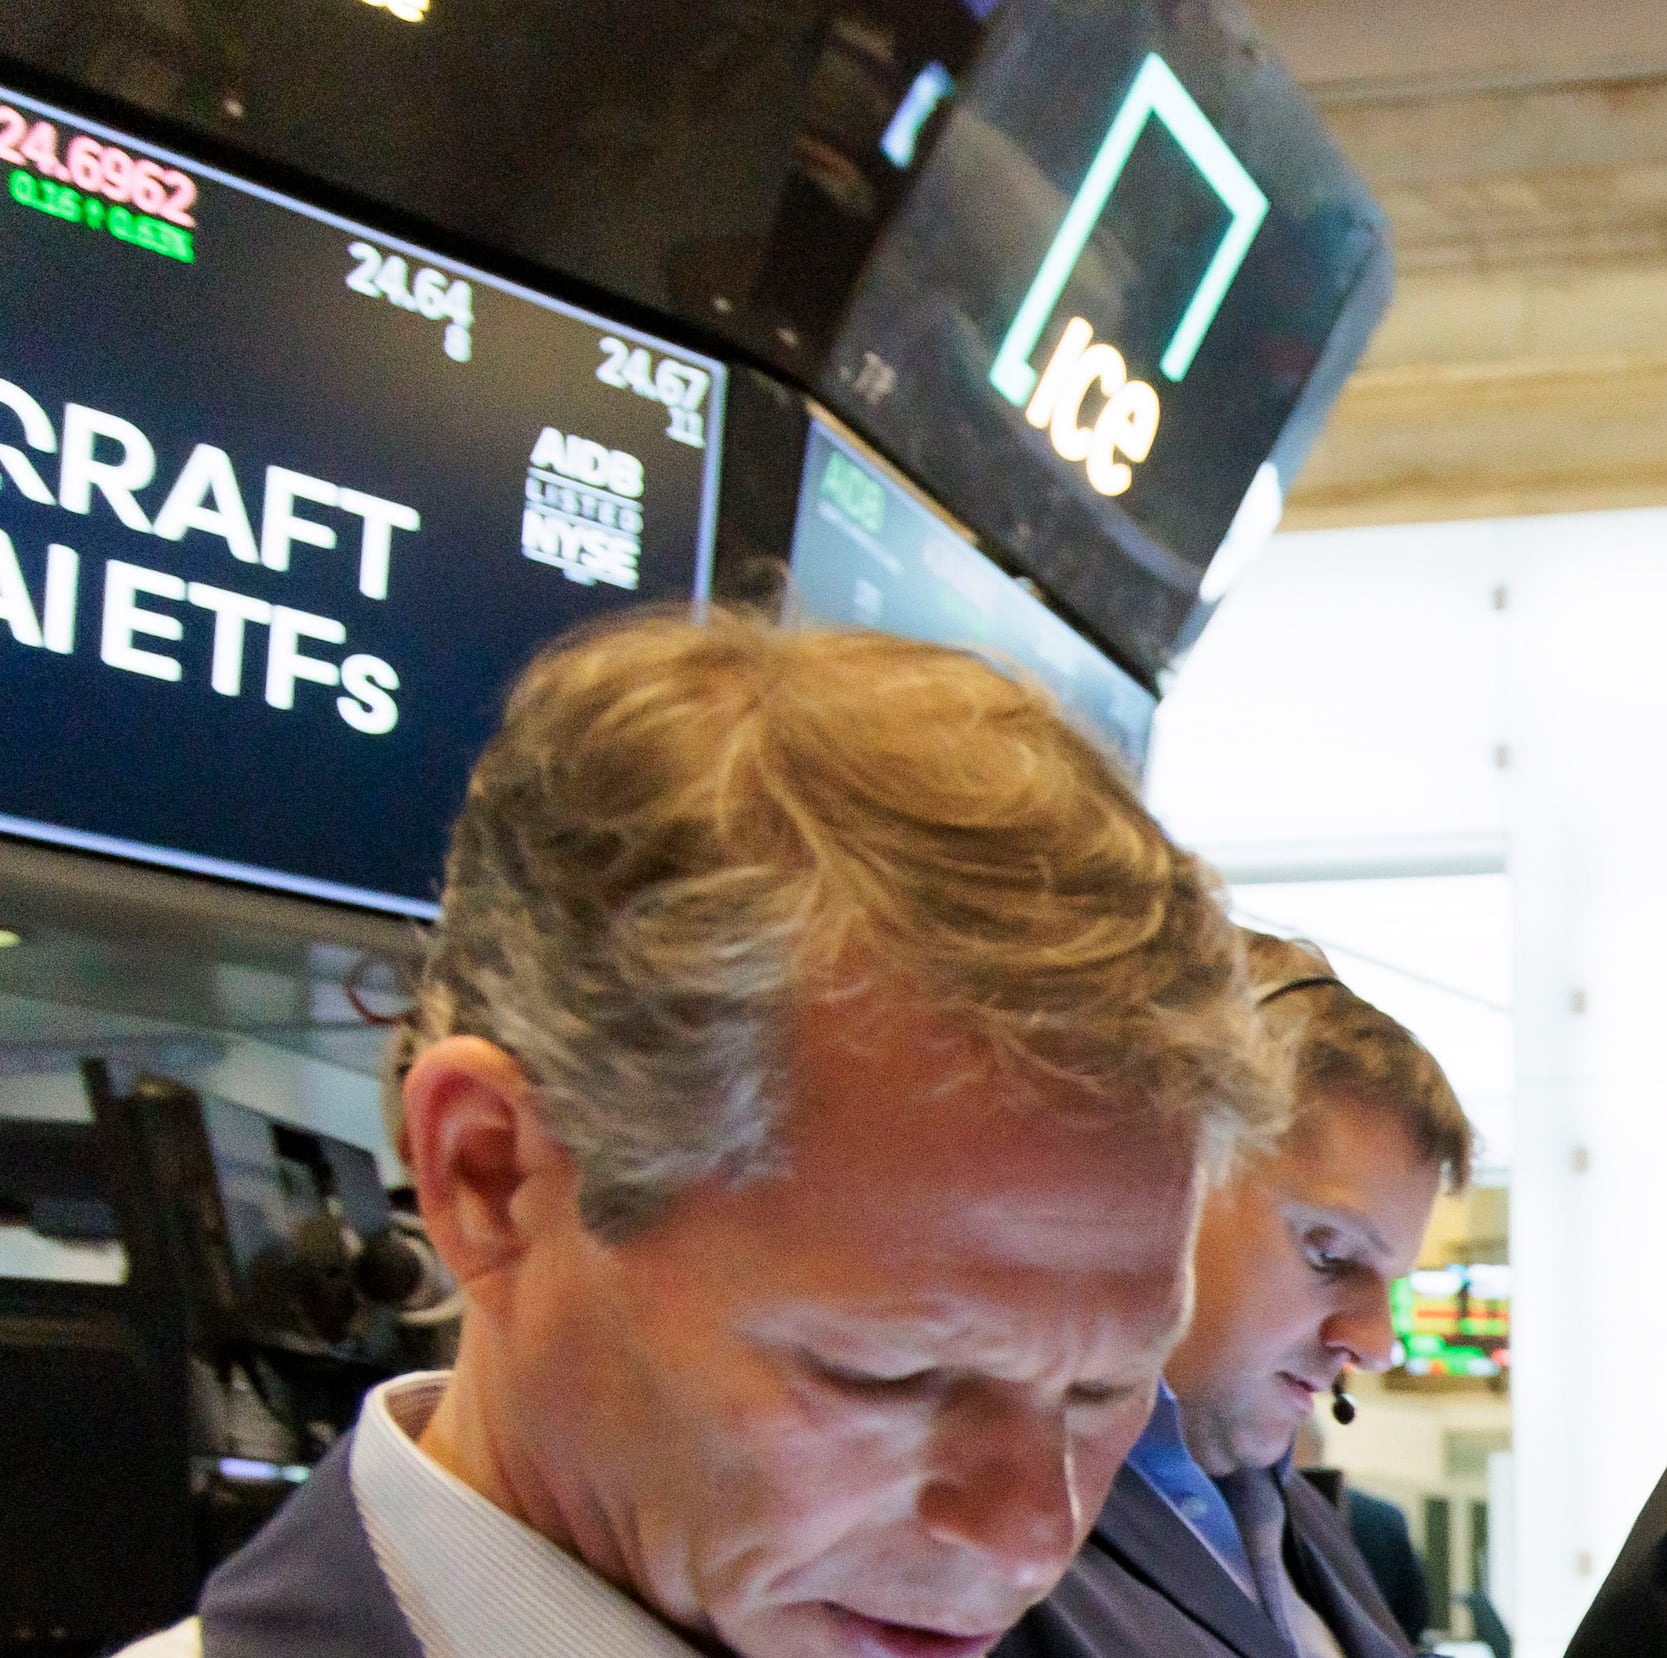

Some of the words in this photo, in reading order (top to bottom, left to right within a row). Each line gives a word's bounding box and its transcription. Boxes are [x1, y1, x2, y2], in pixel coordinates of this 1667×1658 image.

[0, 105, 197, 228] 24.6962
[346, 243, 473, 324] 24.64
[596, 336, 709, 411] 24.67
[530, 426, 644, 498] AIDB
[100, 557, 401, 737] ETFs
